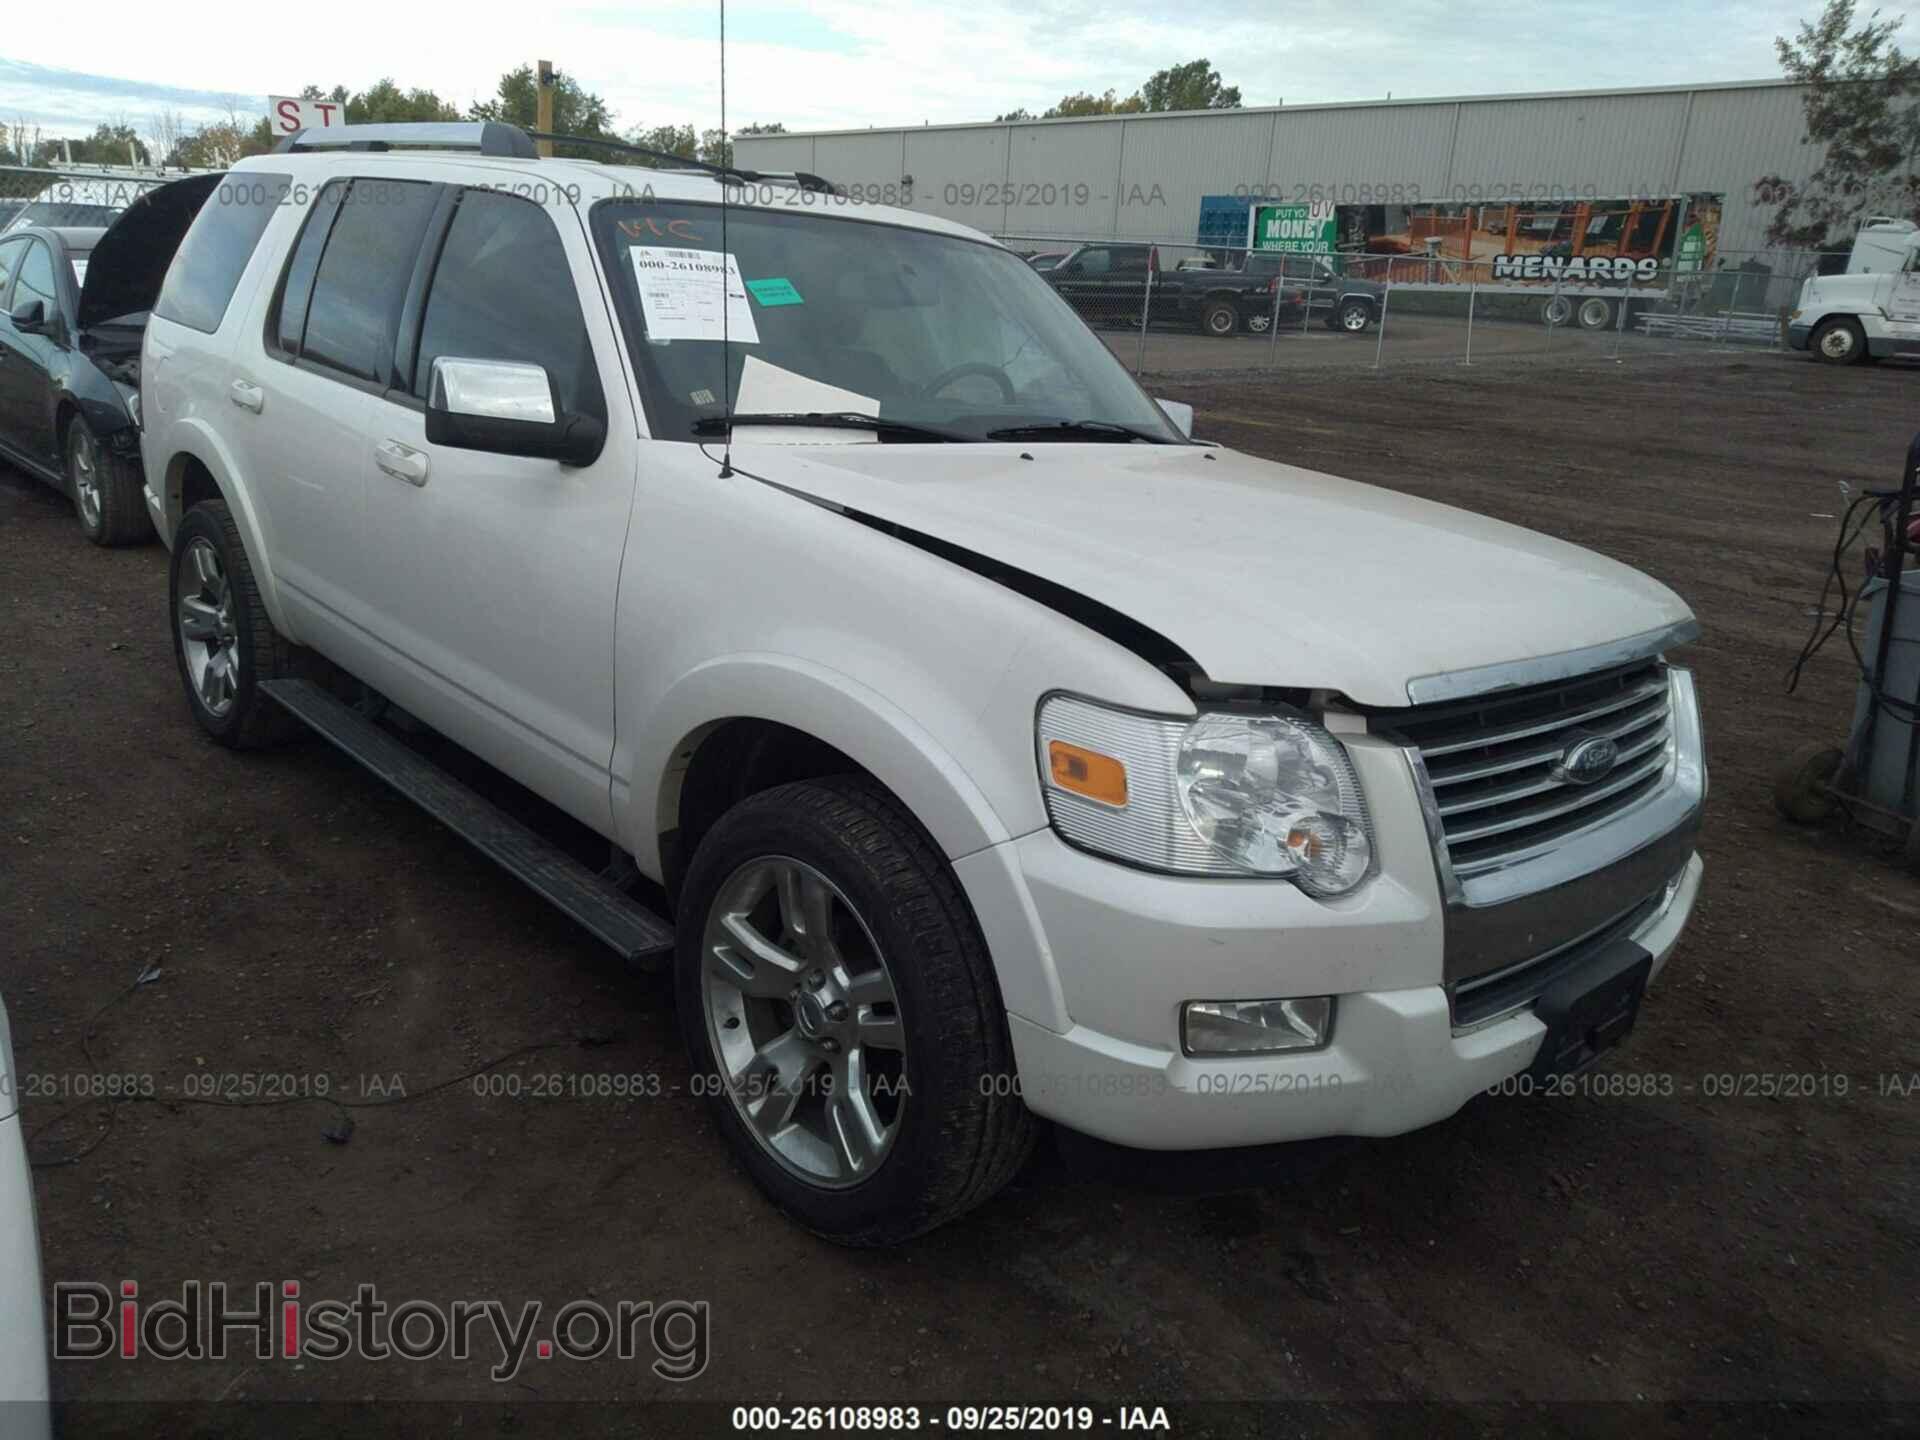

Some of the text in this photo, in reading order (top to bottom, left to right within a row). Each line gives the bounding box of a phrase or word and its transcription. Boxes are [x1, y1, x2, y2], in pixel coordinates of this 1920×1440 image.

[1275, 208, 1294, 219] PUT
[1266, 219, 1327, 239] MONEY
[1262, 241, 1298, 252] WHERE
[1494, 256, 1658, 281] MENARDS
